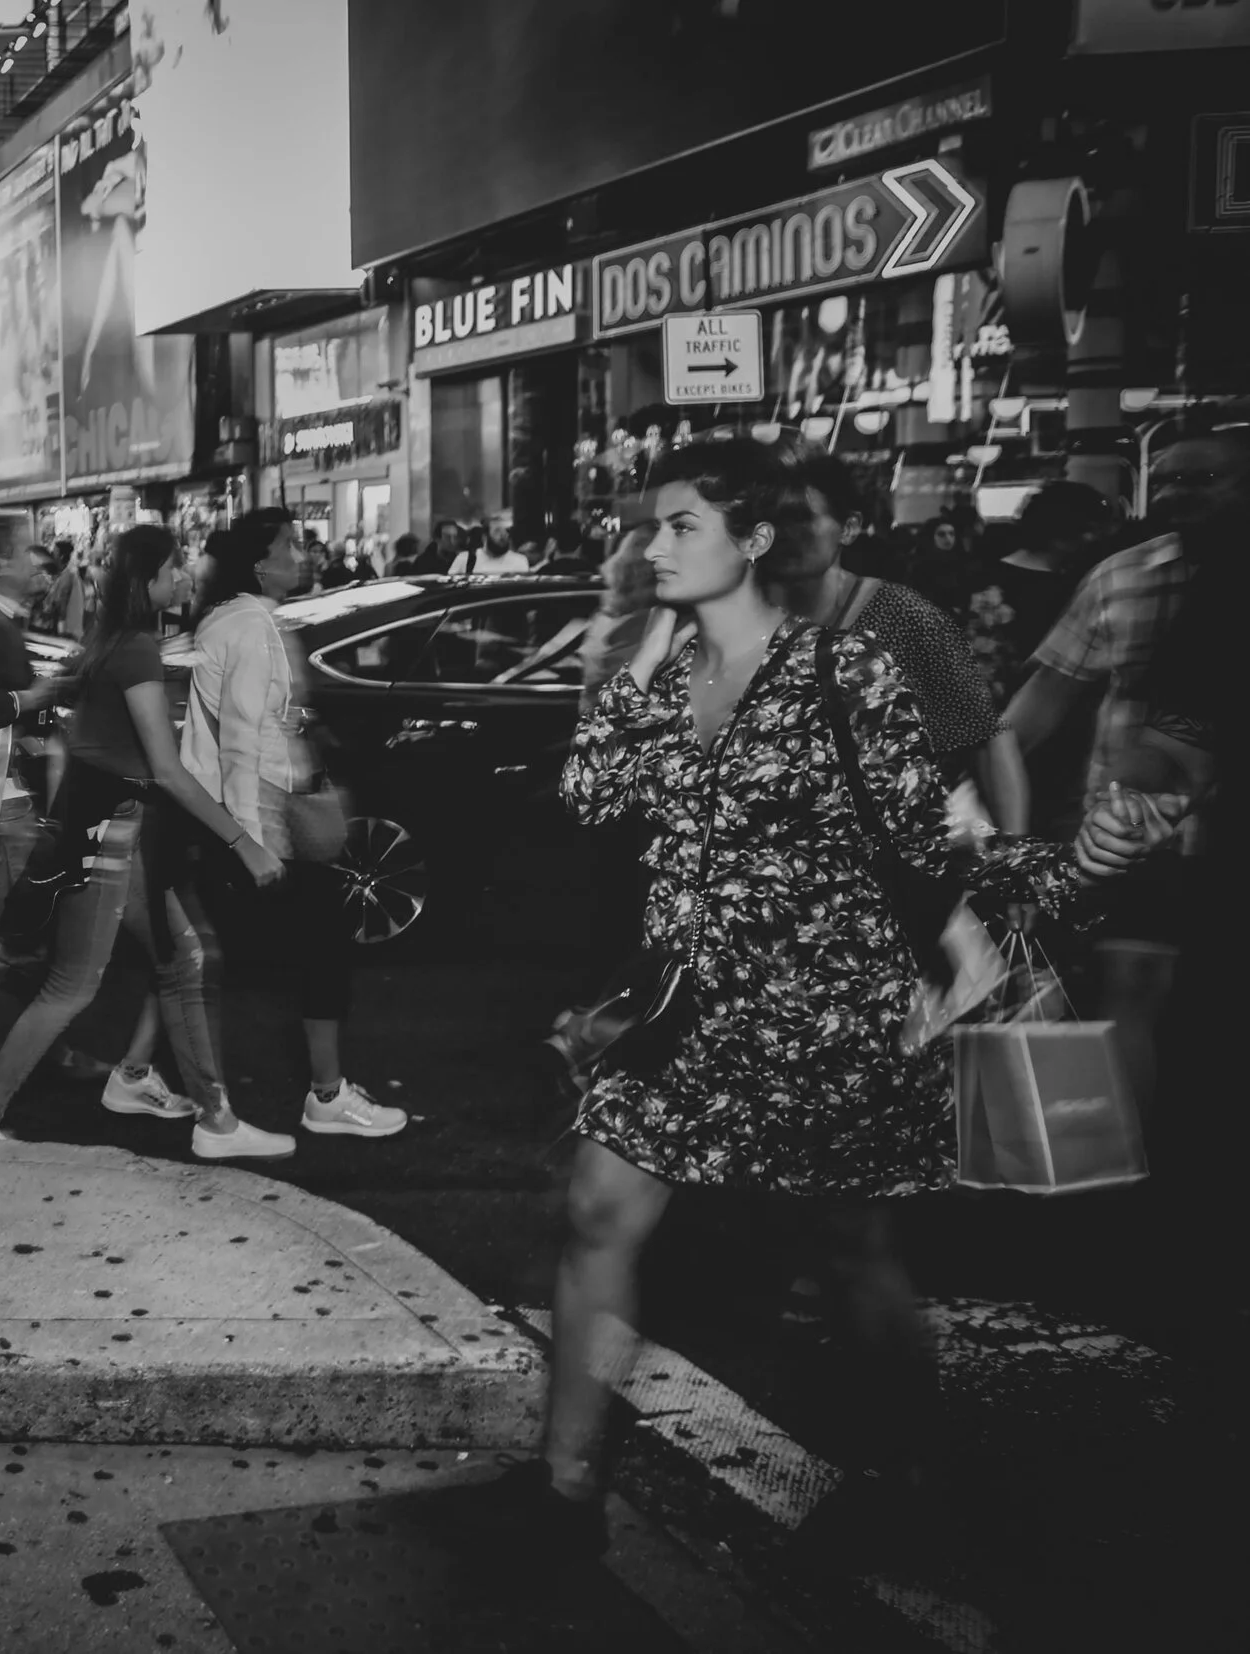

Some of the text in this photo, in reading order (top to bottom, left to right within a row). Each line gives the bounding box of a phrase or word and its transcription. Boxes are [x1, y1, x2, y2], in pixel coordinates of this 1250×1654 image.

[602, 194, 878, 326] DOS CAMINOS
[414, 284, 497, 348] BLUE
[510, 263, 573, 326] FIN
[697, 319, 729, 336] ALL
[685, 339, 742, 354] TRAFFIC
[676, 383, 752, 397] EXCEPT BIKES
